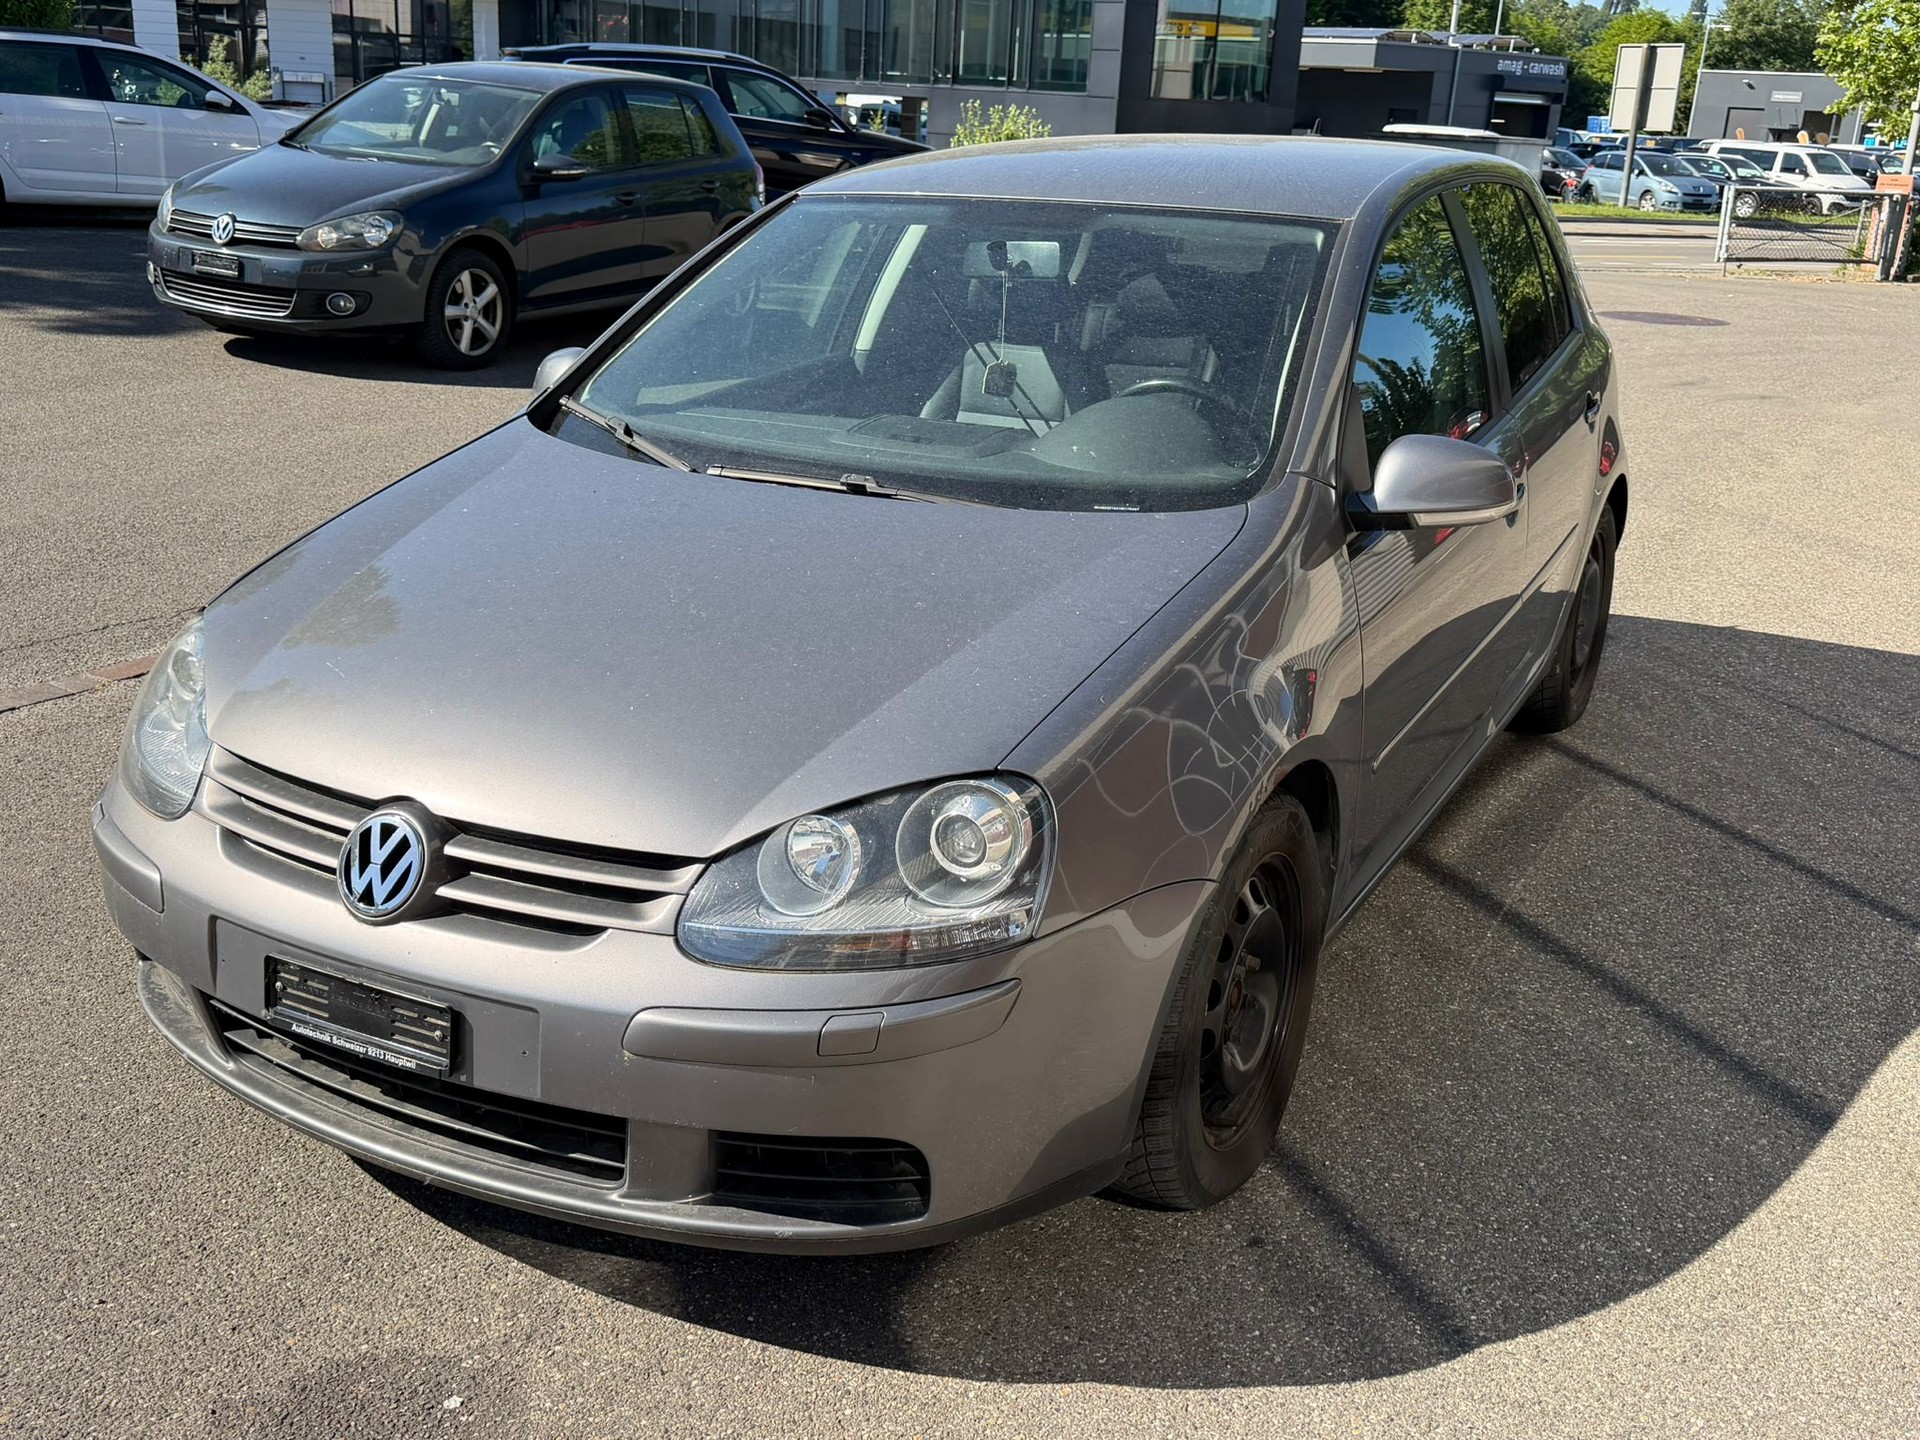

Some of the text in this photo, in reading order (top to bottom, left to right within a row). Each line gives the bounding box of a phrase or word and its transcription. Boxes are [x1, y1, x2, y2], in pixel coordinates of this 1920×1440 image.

[1497, 60, 1523, 75] amag
[1529, 62, 1565, 76] carwash
[212, 214, 233, 243] VW
[340, 811, 423, 914] VW
[292, 1023, 416, 1069] Autotechnik Schweizer 9213 Hauptwil
